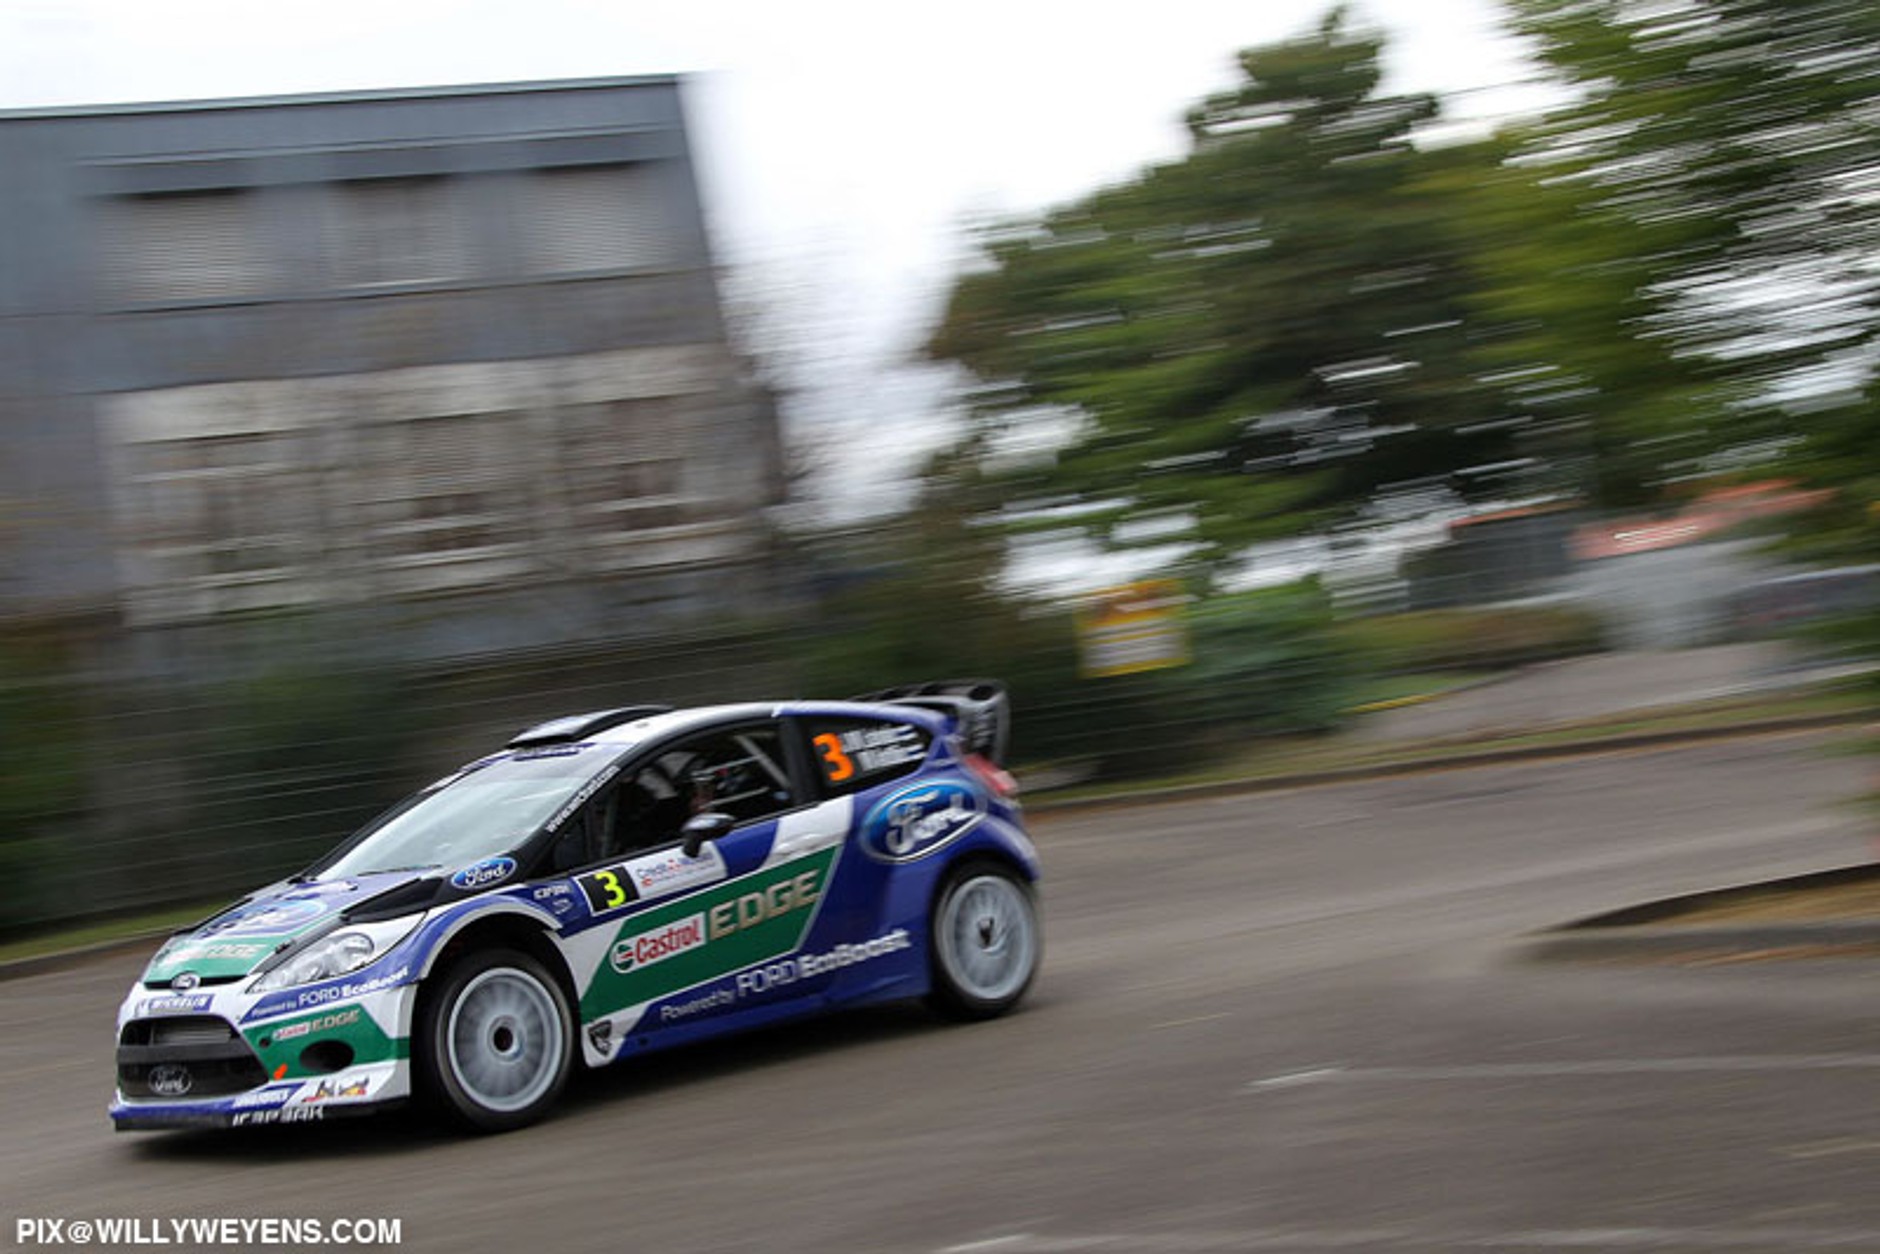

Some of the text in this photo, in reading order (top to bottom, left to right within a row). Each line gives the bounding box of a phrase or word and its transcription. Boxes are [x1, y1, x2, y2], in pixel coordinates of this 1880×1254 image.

[812, 732, 855, 781] 3
[883, 788, 979, 854] Ford
[462, 860, 508, 887] Ford
[594, 871, 626, 908] 3
[634, 869, 824, 965] Castrol EDGE
[298, 985, 341, 1006] FORD
[660, 990, 717, 1021] Powered
[735, 960, 798, 997] FORD
[799, 928, 912, 979] EcoBoost
[311, 1009, 361, 1031] EDGE
